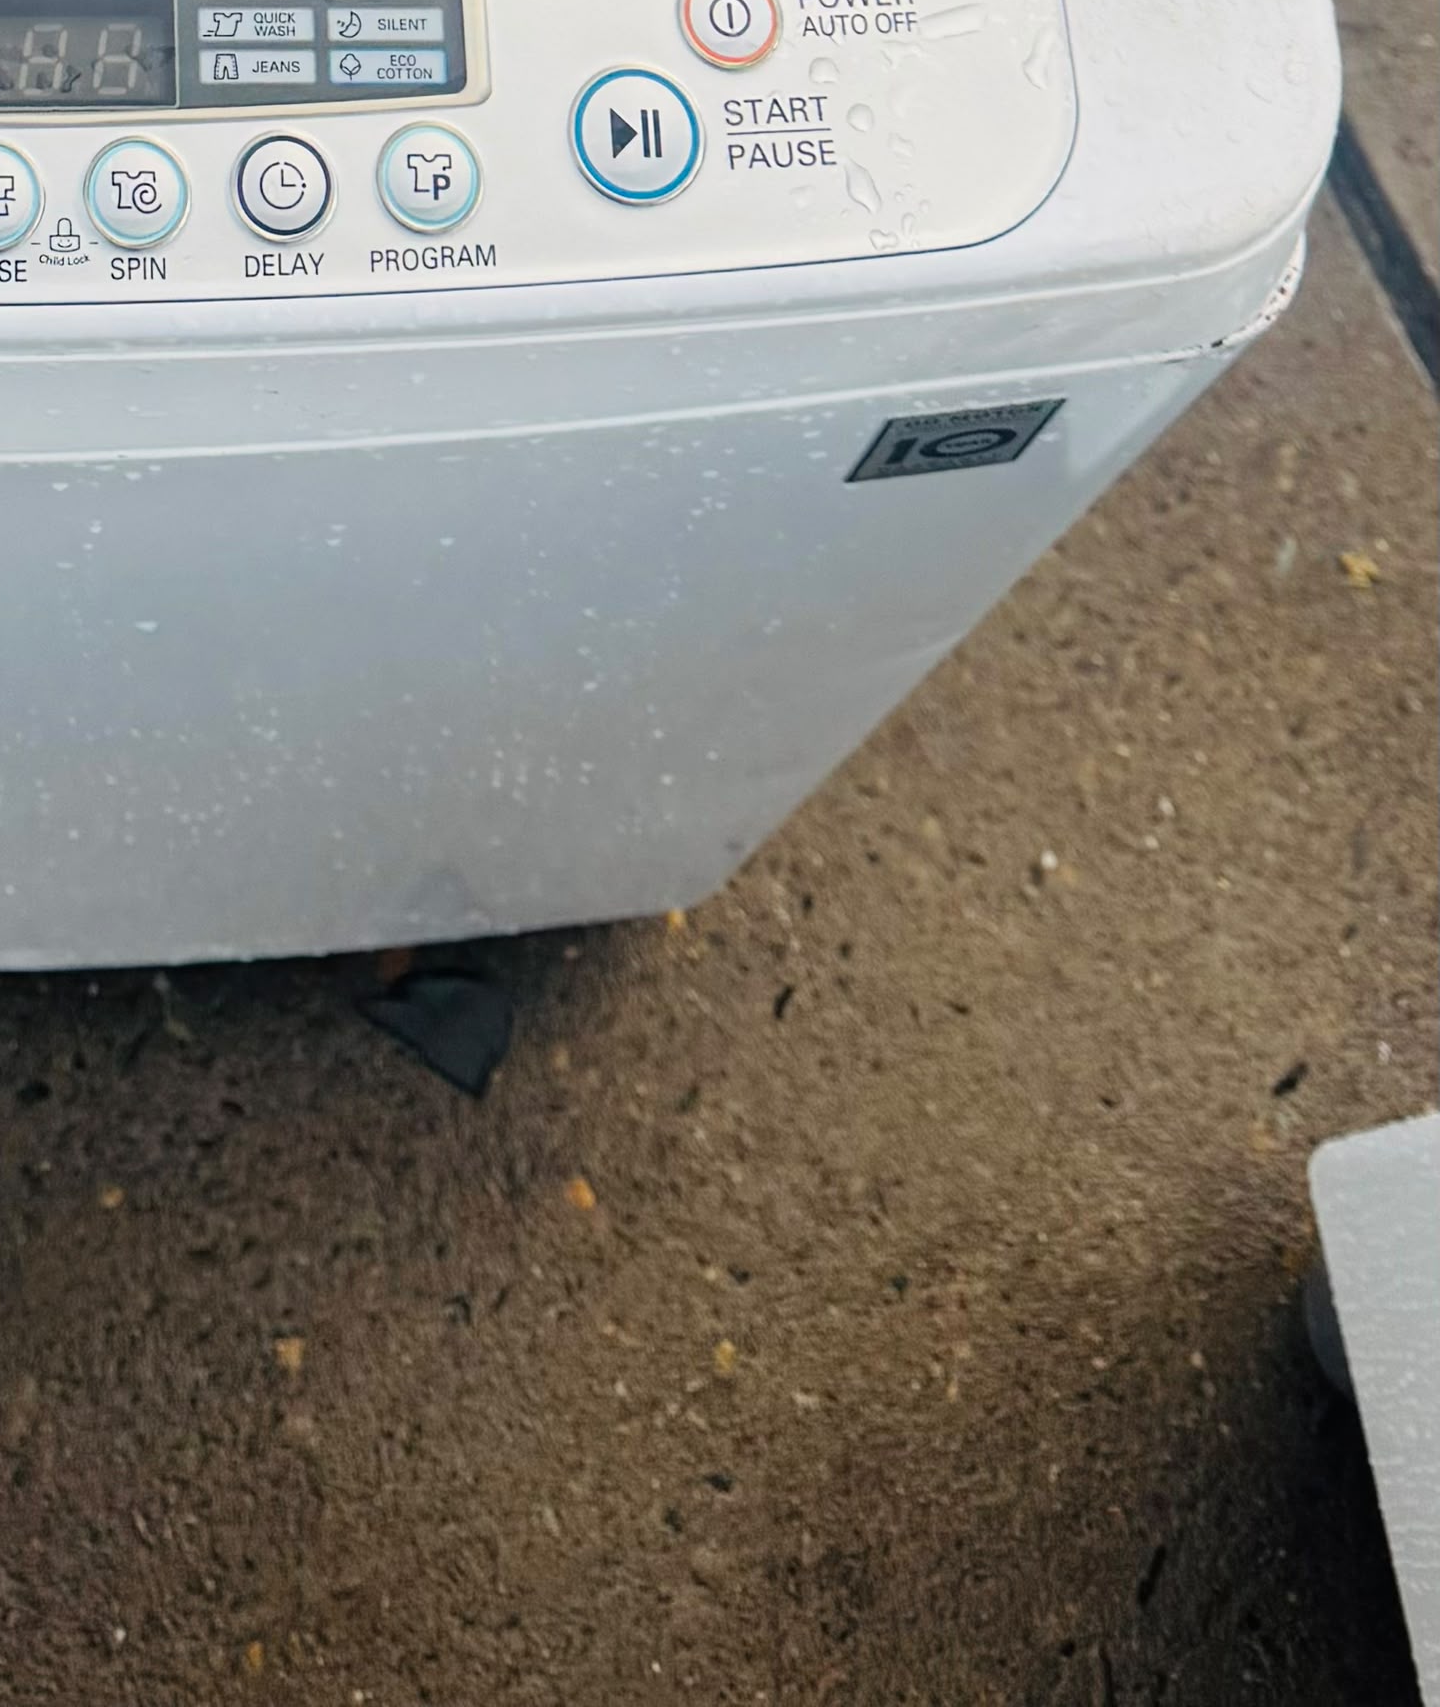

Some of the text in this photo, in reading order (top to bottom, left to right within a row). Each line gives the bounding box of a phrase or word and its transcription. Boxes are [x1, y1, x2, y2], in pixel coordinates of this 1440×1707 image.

[253, 12, 296, 24] QUICK
[377, 18, 428, 31] SILENT
[802, 11, 917, 37] AUTO OFF
[254, 25, 296, 37] WASH
[252, 60, 301, 74] JEANS
[389, 54, 417, 67] ECO
[376, 67, 433, 80] COTTON
[724, 96, 828, 127] START
[727, 139, 837, 170] PAUSE
[244, 251, 325, 277] DELAY
[370, 244, 497, 272] PROGRAM
[110, 256, 167, 281] SPIN
